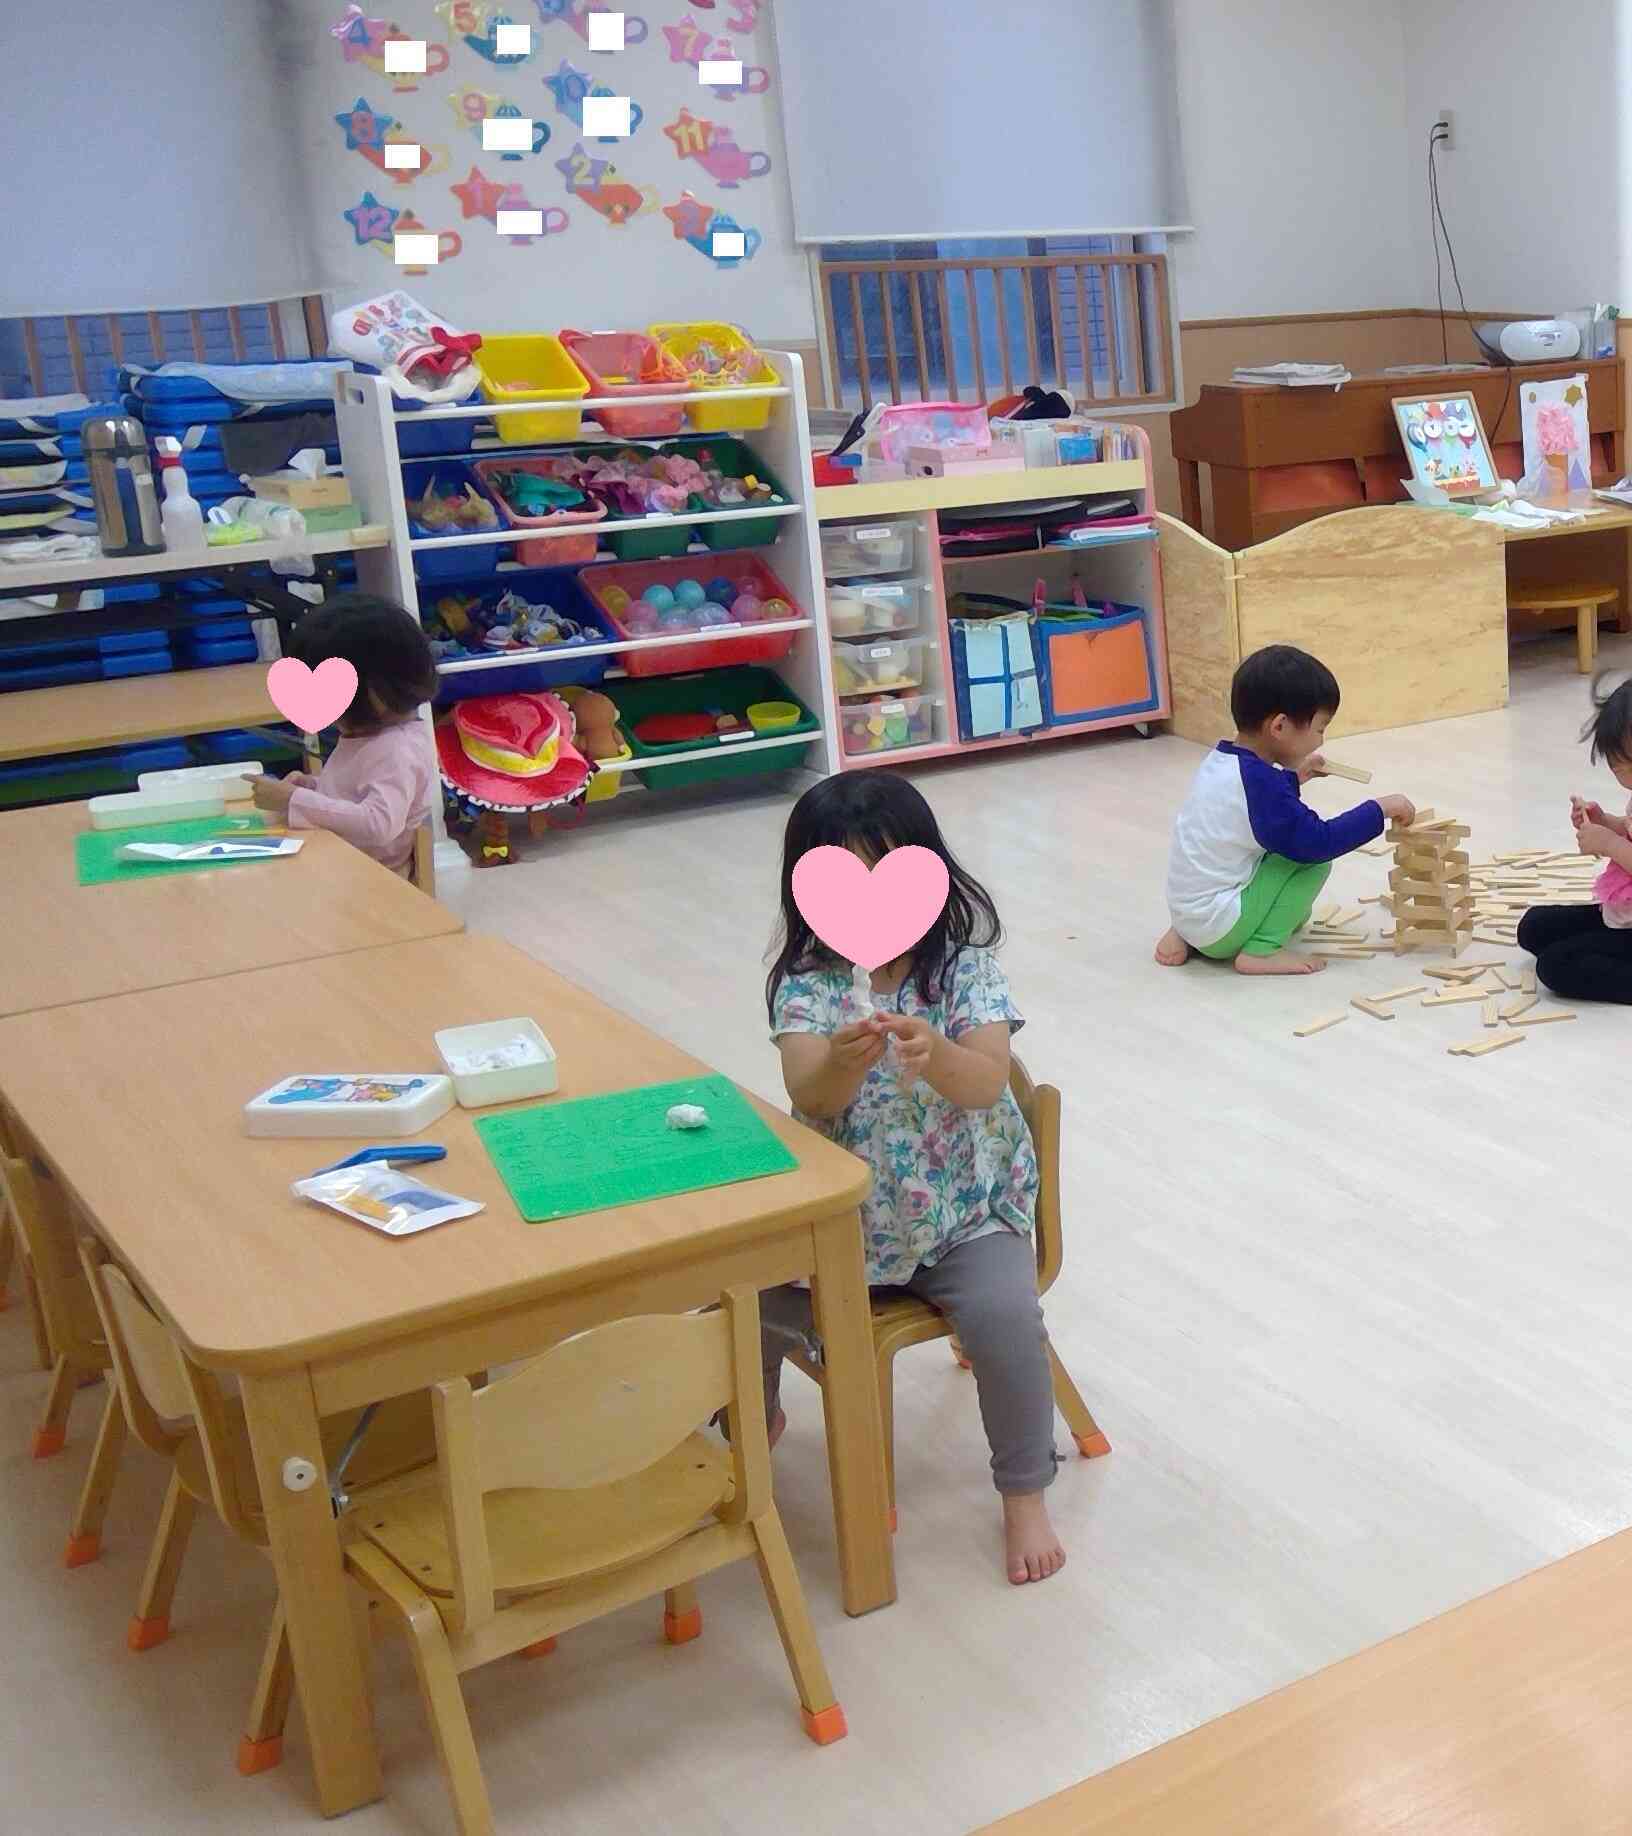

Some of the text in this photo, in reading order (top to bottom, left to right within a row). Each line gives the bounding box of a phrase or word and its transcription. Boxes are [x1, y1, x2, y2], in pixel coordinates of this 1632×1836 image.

[348, 18, 371, 44] 4
[454, 2, 476, 32] 5
[463, 93, 486, 120] 9
[675, 121, 705, 153] 11
[571, 154, 593, 184] 2
[356, 207, 391, 240] 12
